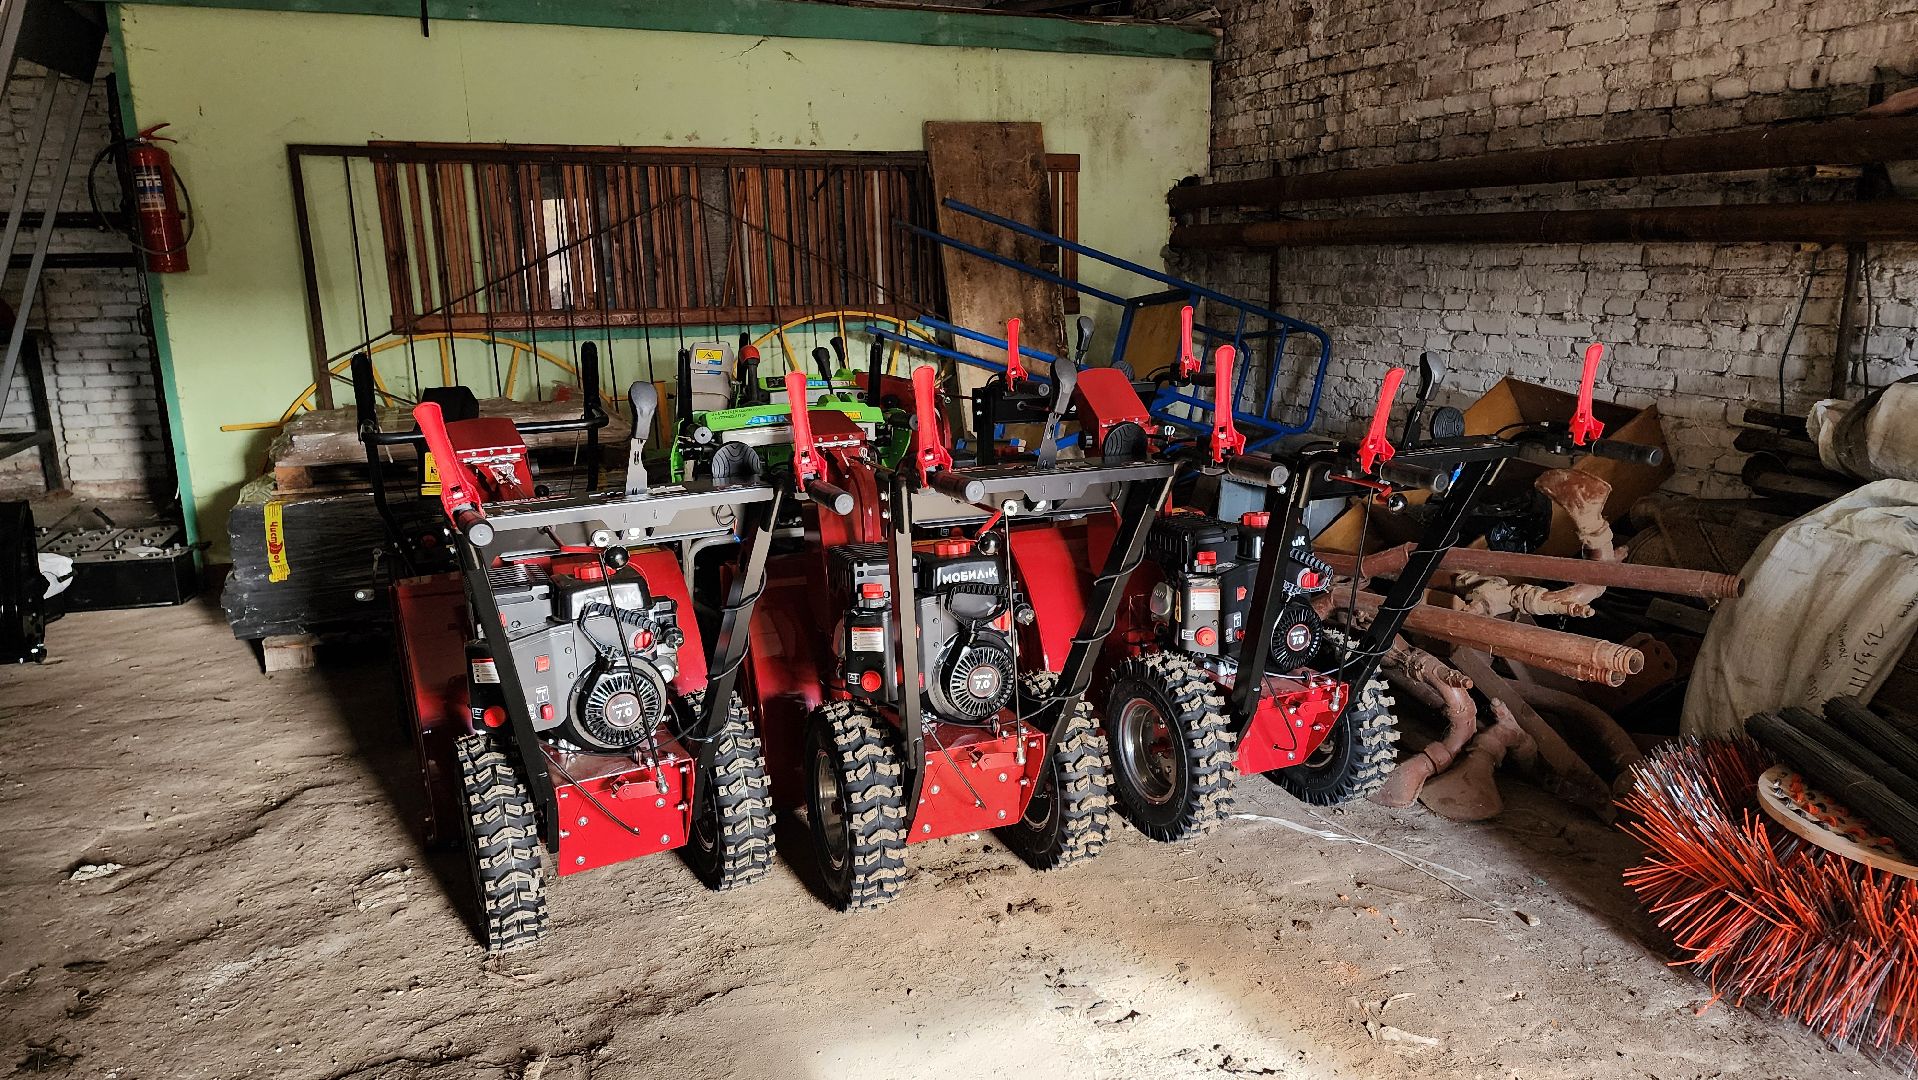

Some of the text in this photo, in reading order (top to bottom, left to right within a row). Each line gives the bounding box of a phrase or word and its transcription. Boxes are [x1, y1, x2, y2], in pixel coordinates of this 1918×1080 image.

[1292, 636, 1305, 645] 7.0
[975, 680, 990, 690] 7.0
[615, 707, 633, 720] 7.0
